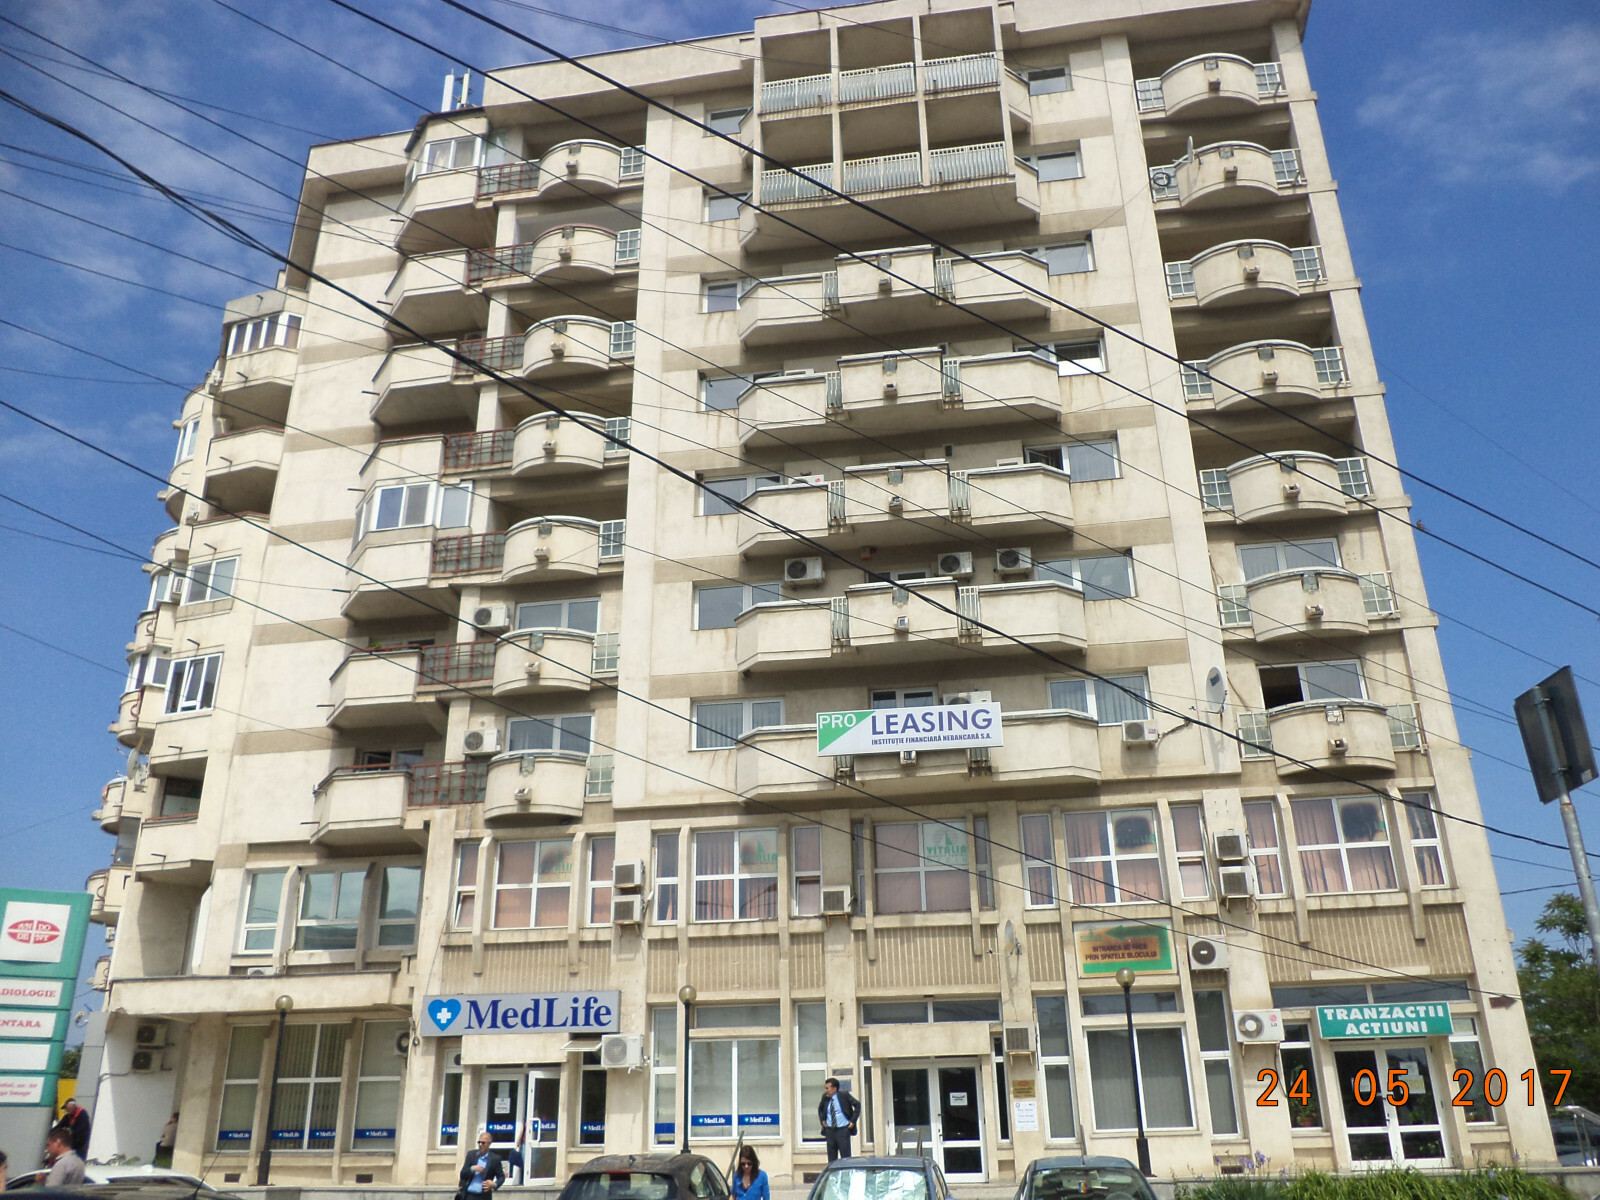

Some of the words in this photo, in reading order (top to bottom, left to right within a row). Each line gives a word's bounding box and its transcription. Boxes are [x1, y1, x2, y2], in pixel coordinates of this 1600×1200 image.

[819, 713, 857, 729] PRO
[871, 708, 993, 736] LEASING
[1100, 952, 1126, 960] SPATELE
[0, 988, 57, 998] DIOLOGIE
[464, 996, 612, 1030] MedLife
[1323, 1005, 1445, 1021] TRANZACTII
[0, 1019, 41, 1028] NTARA
[1345, 1021, 1428, 1035] ACTIUNI
